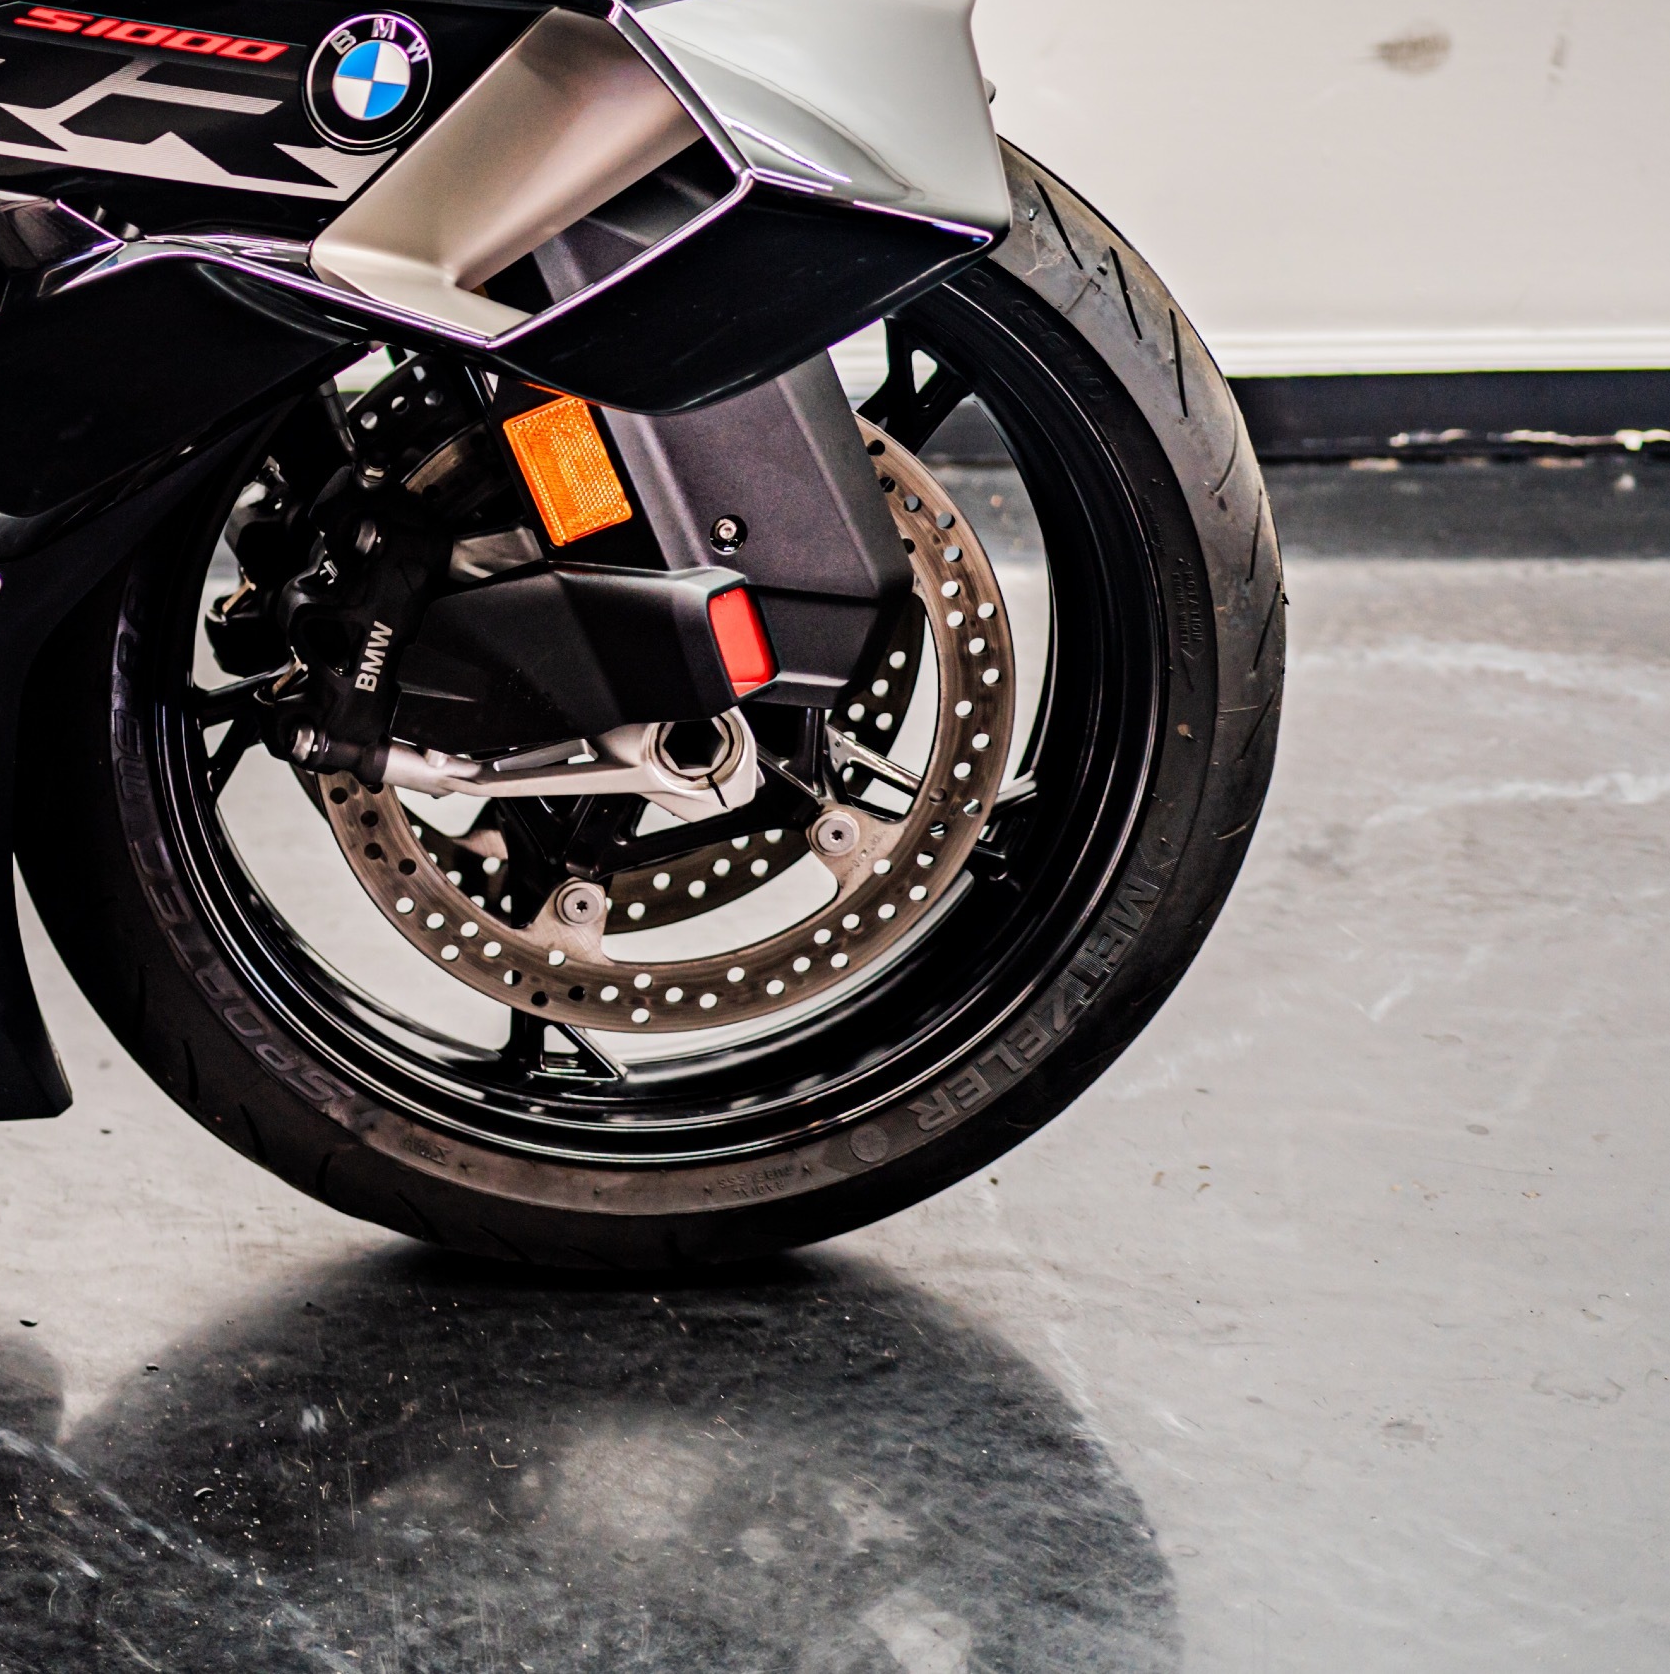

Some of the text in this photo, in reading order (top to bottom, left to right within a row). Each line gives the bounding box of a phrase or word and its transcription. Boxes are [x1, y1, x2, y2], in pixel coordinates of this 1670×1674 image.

[14, 6, 290, 63] S1000
[330, 17, 428, 64] BMW
[355, 620, 393, 692] BMW
[131, 836, 358, 1103] SPORTEC
[907, 876, 1161, 1131] METZELER
